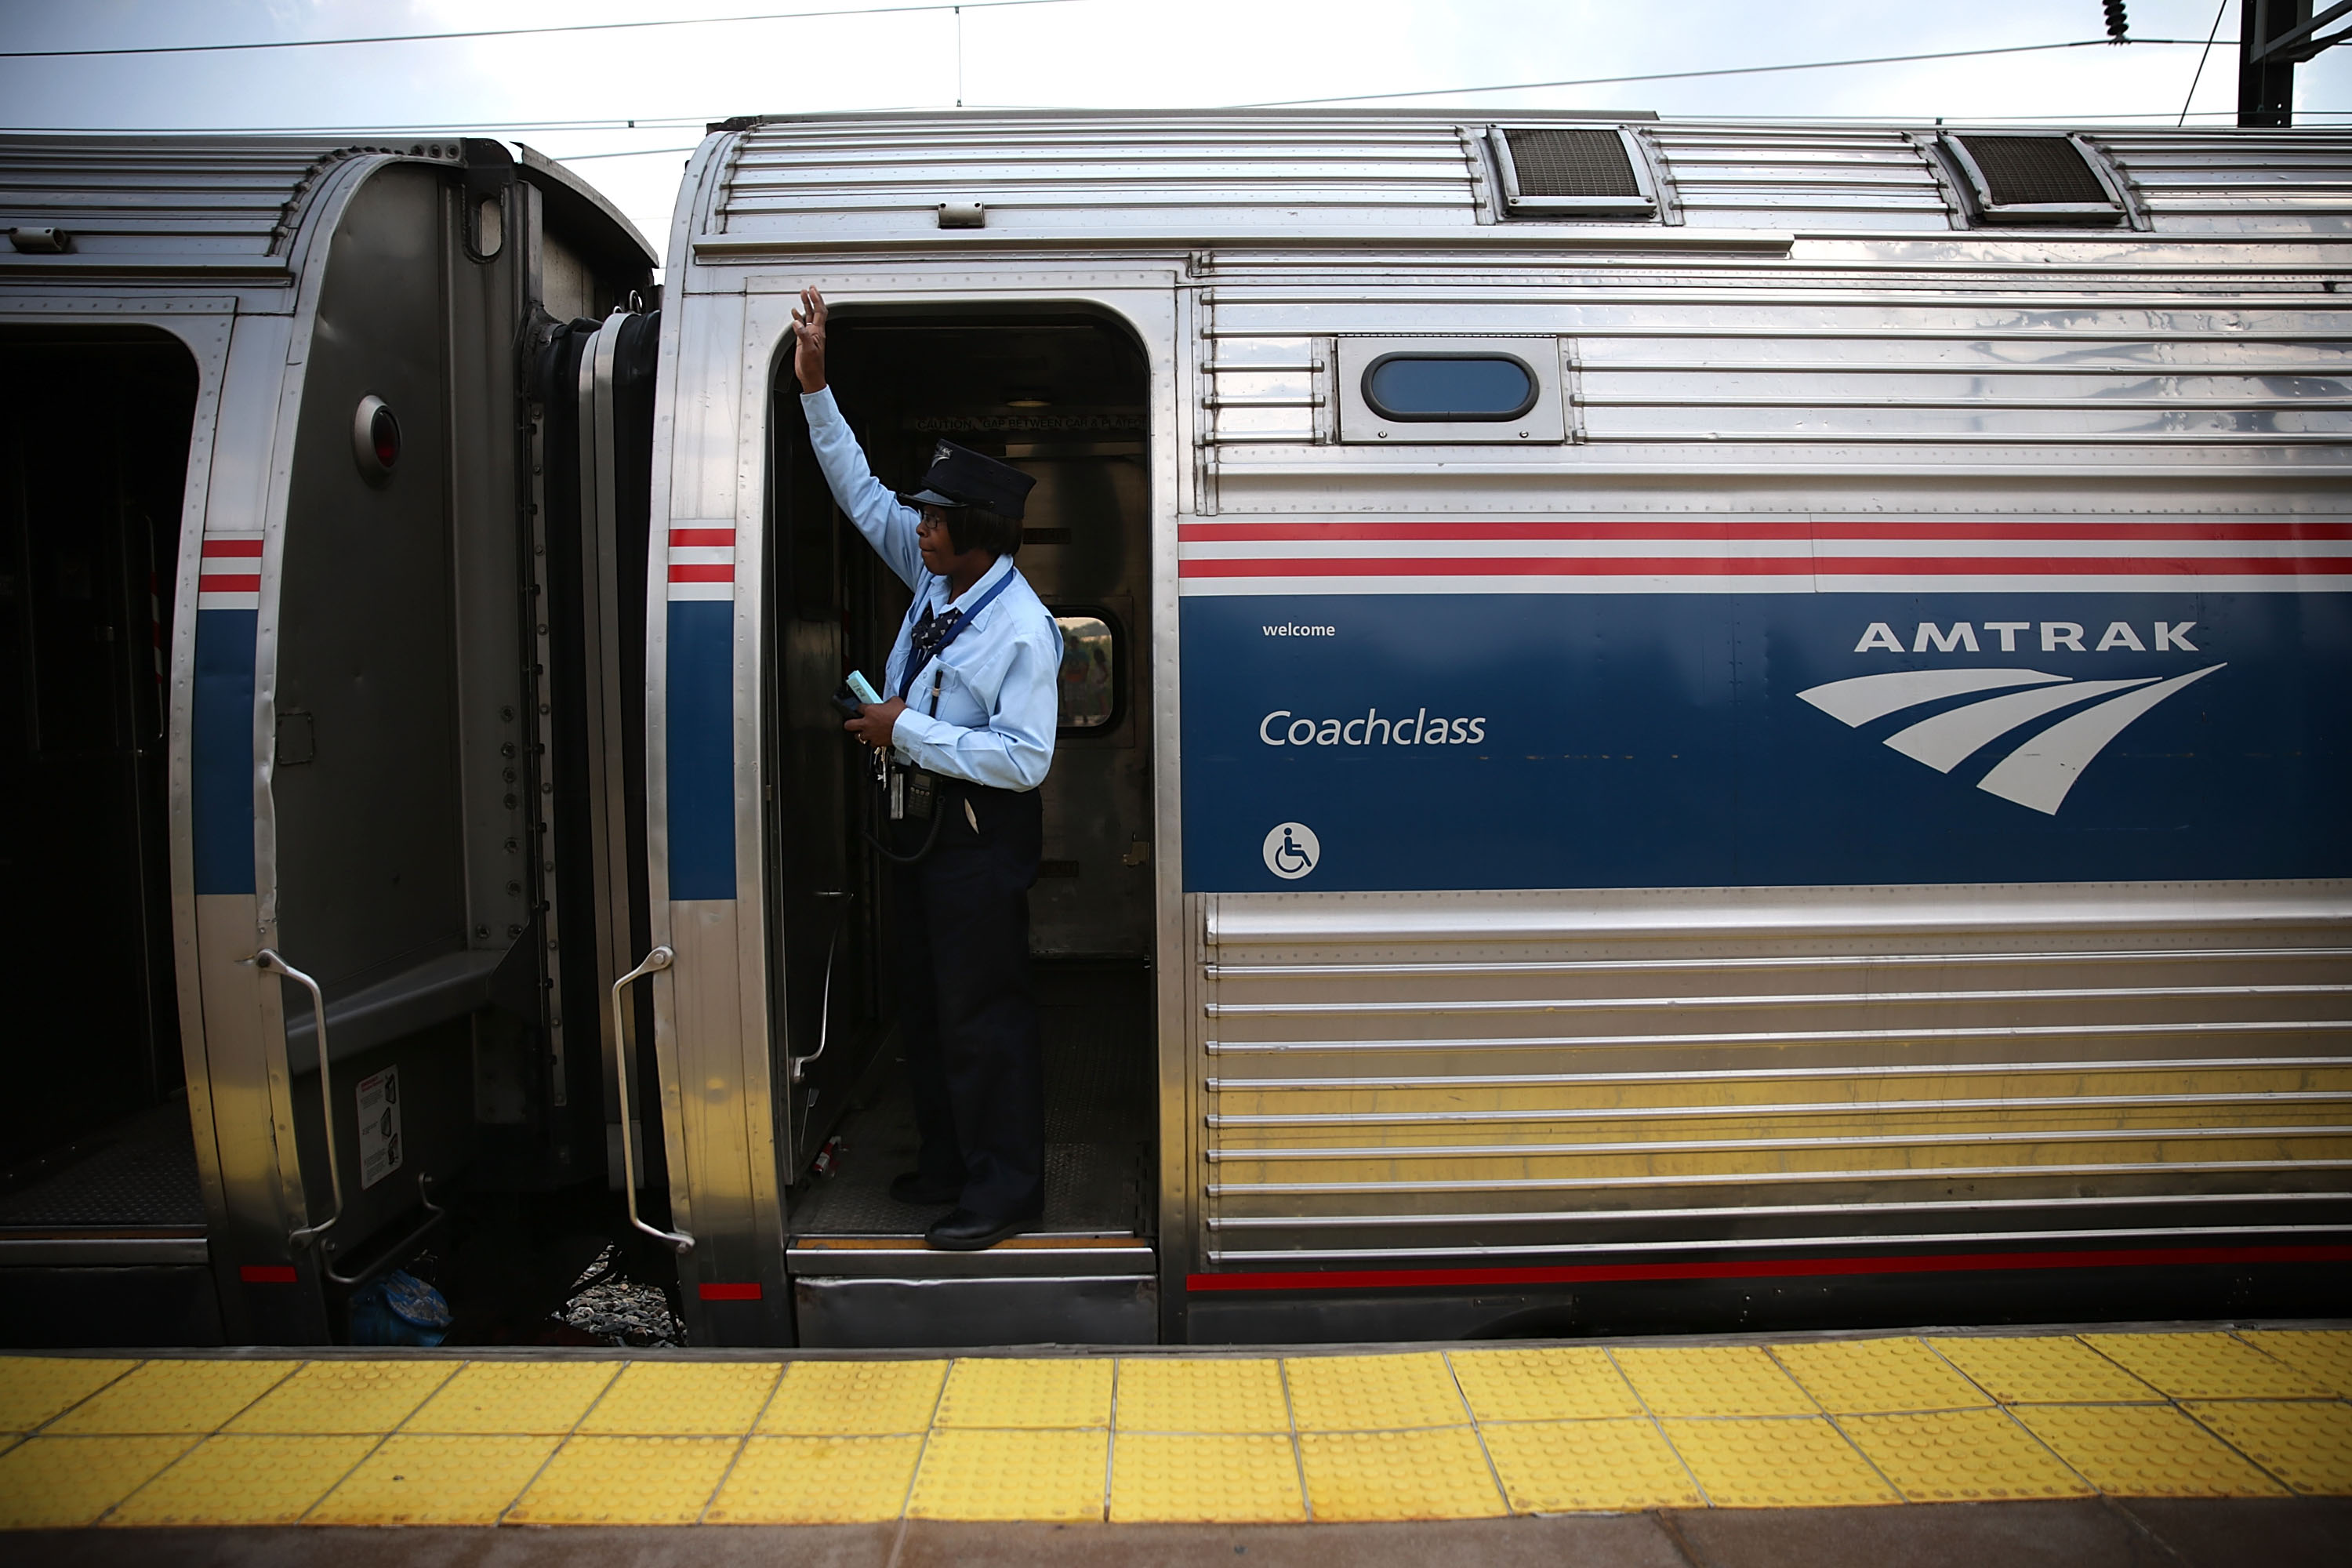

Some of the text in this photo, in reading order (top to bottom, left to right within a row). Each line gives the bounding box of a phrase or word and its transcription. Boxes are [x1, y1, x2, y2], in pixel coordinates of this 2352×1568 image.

[983, 419, 1004, 428] GAP
[1262, 622, 1335, 637] welcome
[1853, 622, 2199, 652] AMTRAK
[1259, 707, 1486, 746] Coachclass
